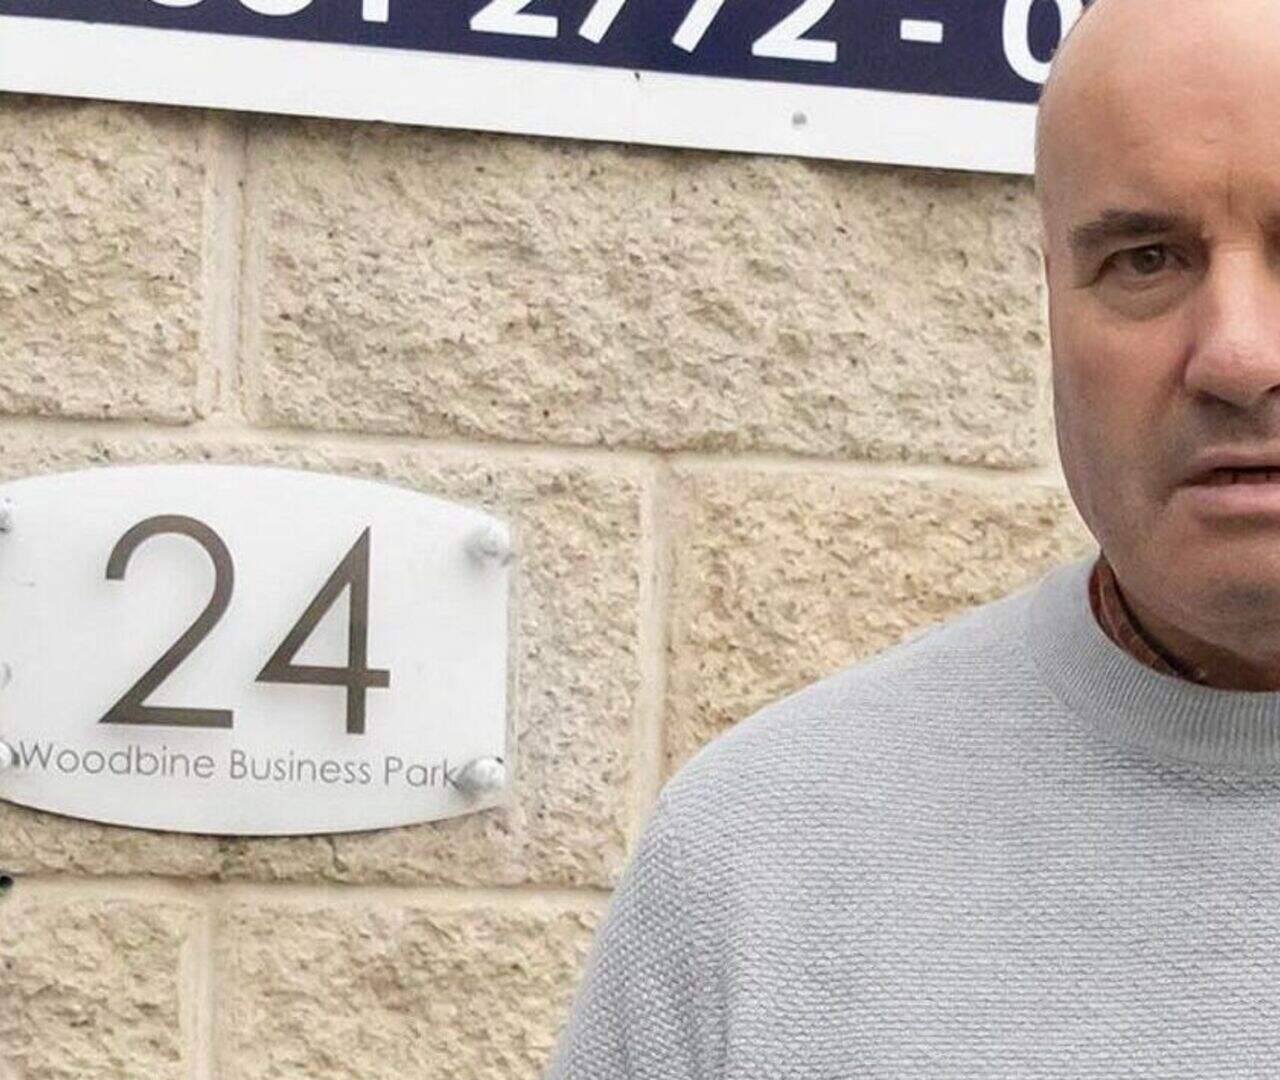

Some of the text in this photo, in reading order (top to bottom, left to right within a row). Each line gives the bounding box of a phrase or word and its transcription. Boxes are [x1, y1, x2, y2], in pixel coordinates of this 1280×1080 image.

[97, 513, 391, 736] 24
[19, 740, 463, 792] Woodbine Business Park
